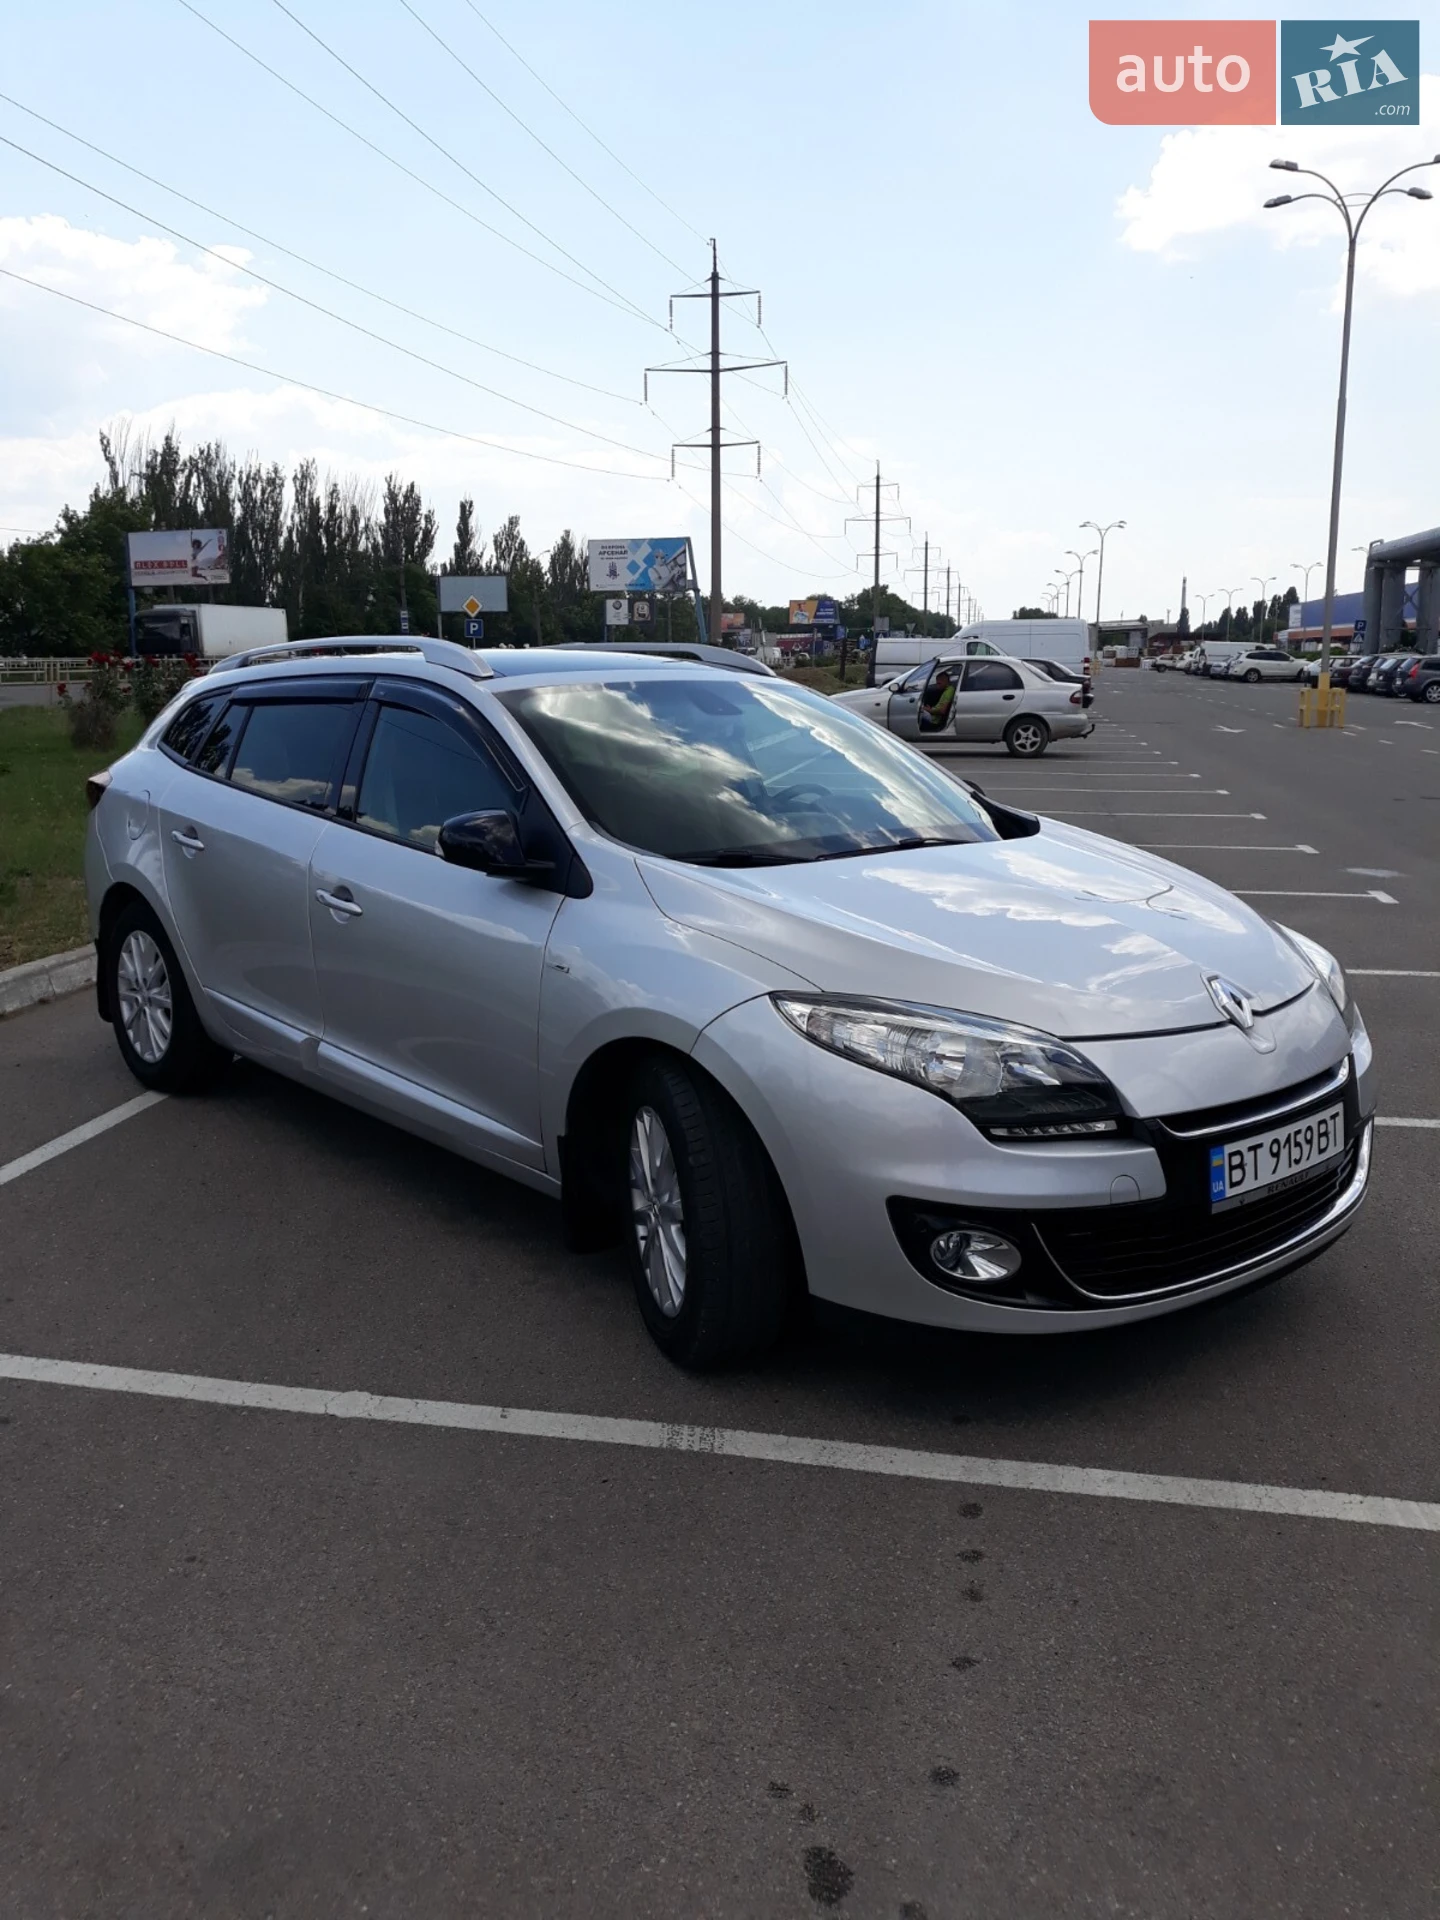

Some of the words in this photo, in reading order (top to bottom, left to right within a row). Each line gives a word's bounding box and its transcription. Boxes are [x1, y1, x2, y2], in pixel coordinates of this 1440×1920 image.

[469, 622, 479, 635] P
[1228, 1142, 1265, 1190] BT
[1269, 1125, 1314, 1175] 9159
[1317, 1111, 1340, 1155] BT
[1212, 1180, 1225, 1193] UA
